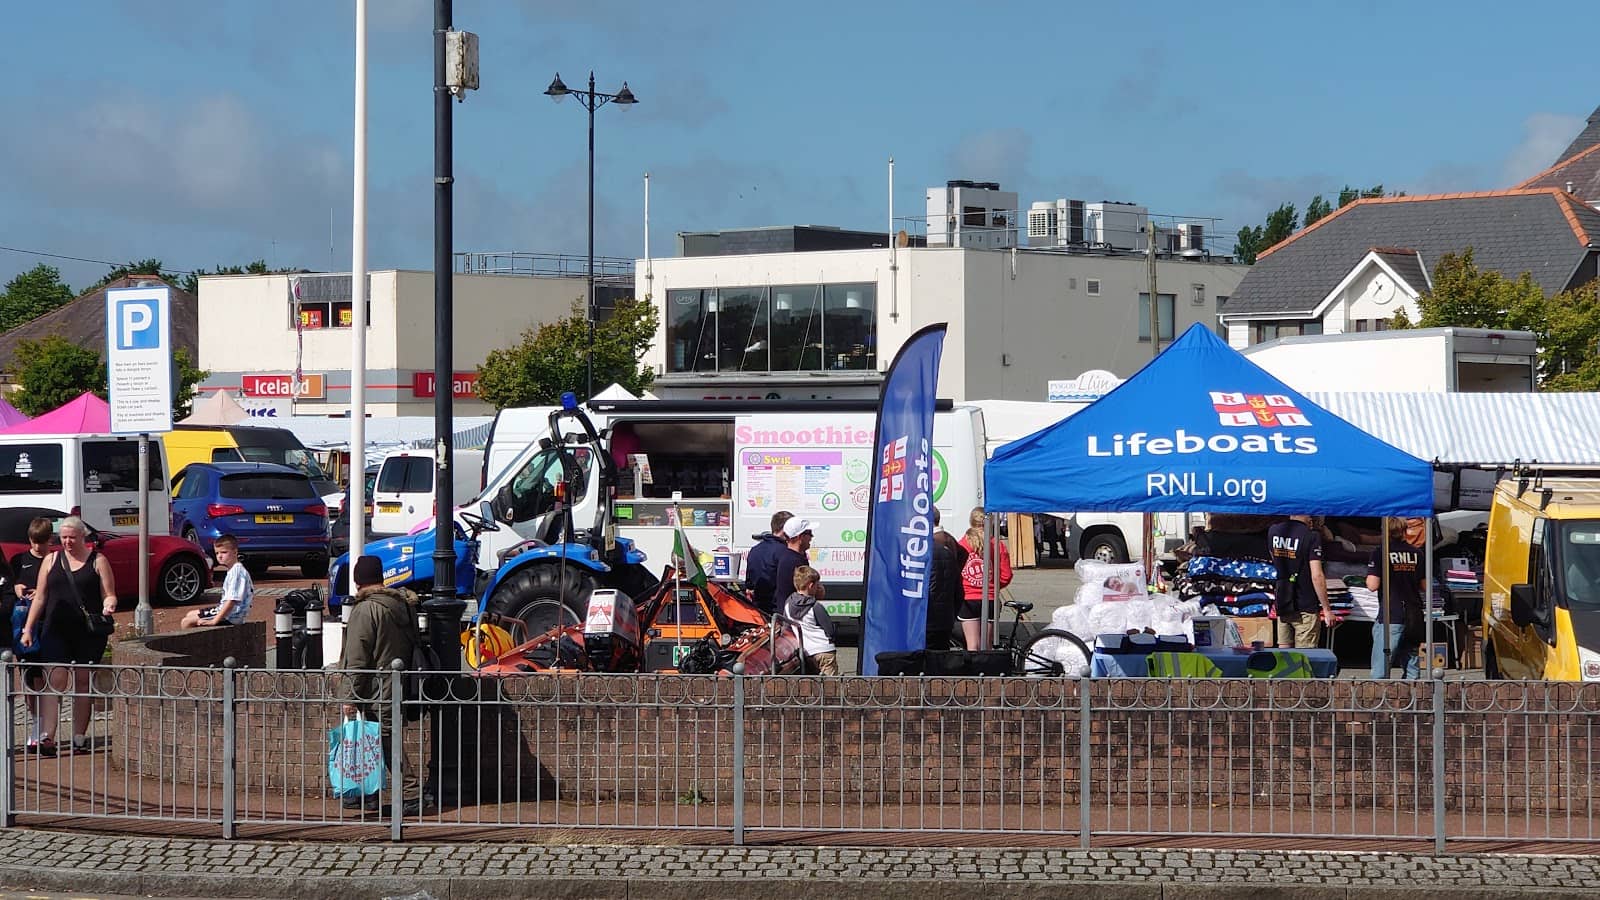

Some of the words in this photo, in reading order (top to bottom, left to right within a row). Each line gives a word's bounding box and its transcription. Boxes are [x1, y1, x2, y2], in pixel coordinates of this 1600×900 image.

[123, 303, 153, 347] P
[736, 426, 875, 444] Smoothie
[1087, 429, 1318, 457] Lifeboats
[763, 455, 791, 465] Swig
[1147, 472, 1267, 503] RNLI.org
[1272, 535, 1300, 551] RNLI
[831, 550, 858, 562] FRESHLY
[1389, 551, 1418, 565] RNLI
